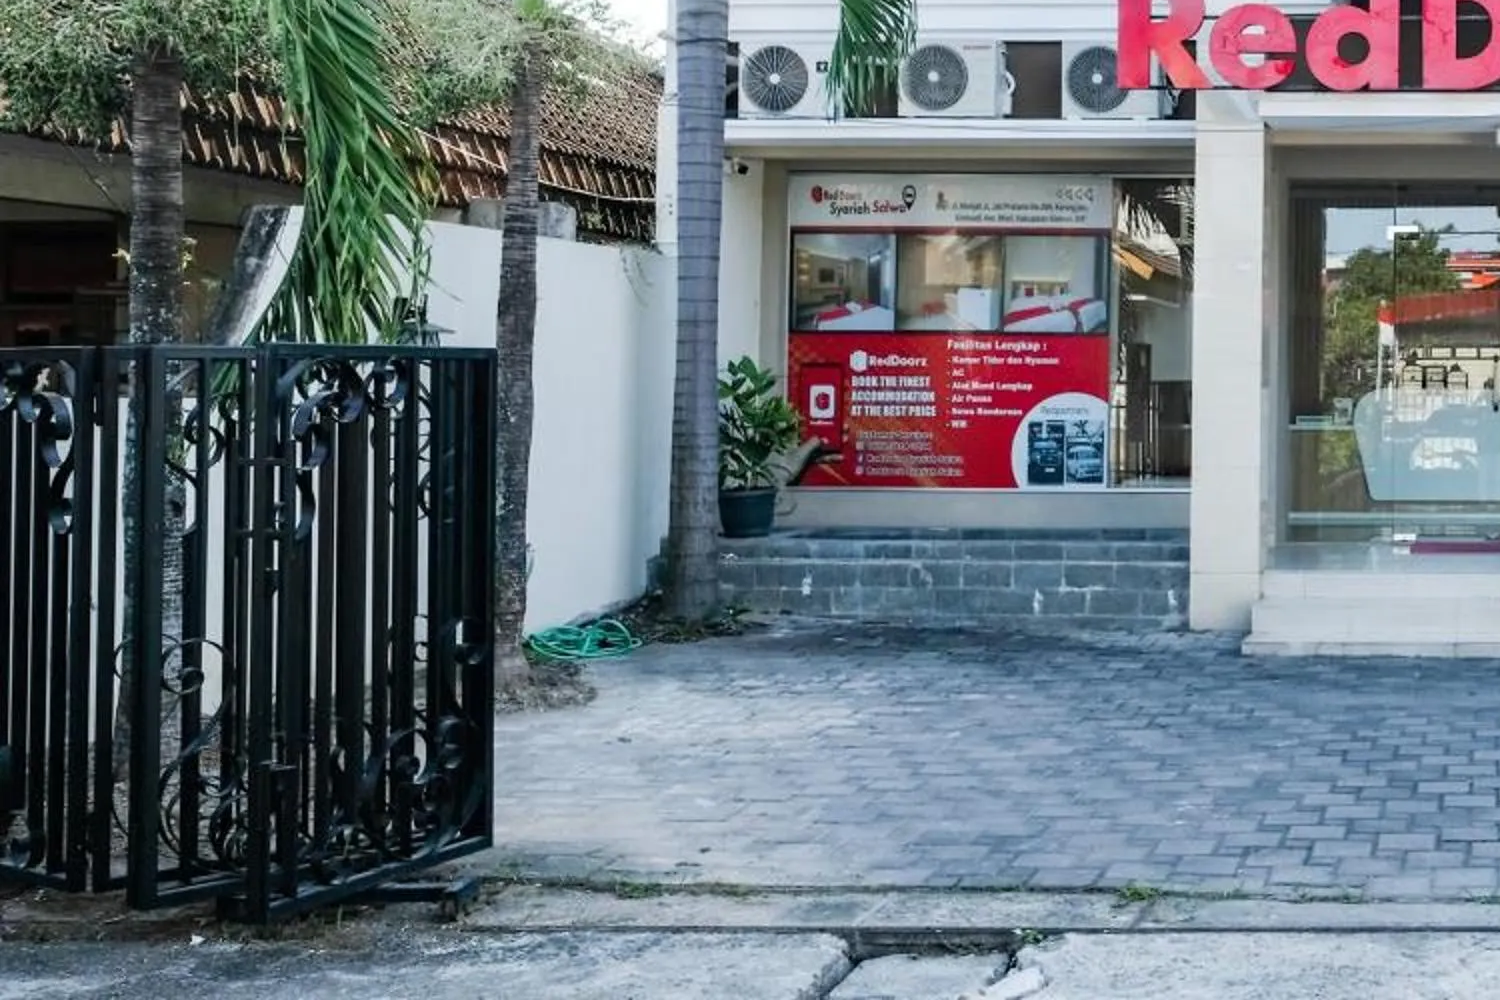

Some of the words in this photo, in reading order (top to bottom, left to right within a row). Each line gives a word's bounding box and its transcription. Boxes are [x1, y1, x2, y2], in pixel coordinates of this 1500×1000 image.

[829, 201, 871, 217] Syariah
[869, 354, 928, 367] RedDoorz
[880, 376, 897, 387] THE
[864, 405, 881, 416] THE
[883, 405, 907, 416] BEST
[908, 405, 936, 416] PRICE
